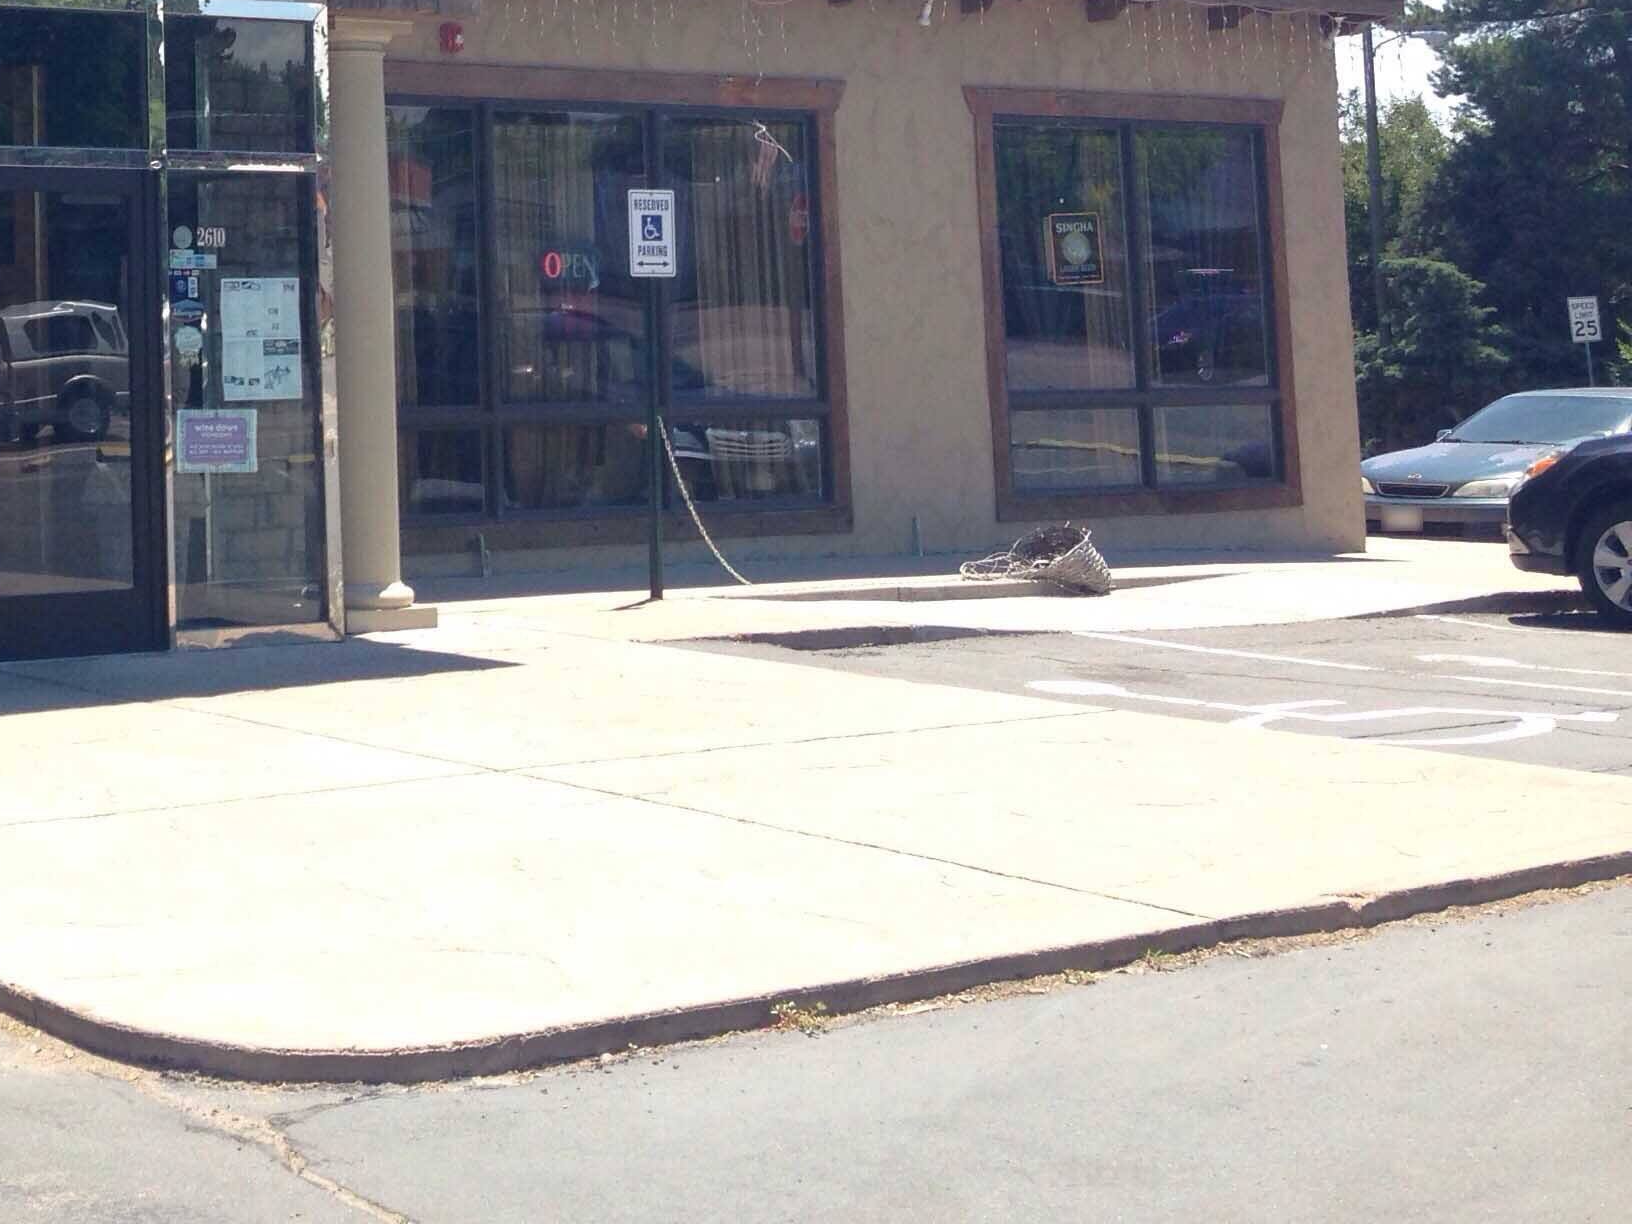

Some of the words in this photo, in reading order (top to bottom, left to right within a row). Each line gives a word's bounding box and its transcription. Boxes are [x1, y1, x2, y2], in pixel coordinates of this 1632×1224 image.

[634, 201, 670, 212] RESERVED
[1056, 222, 1093, 233] SINGHA
[197, 227, 226, 247] 2610
[637, 245, 669, 257] PARKING
[543, 251, 600, 280] OPEN
[1574, 320, 1598, 337] 25
